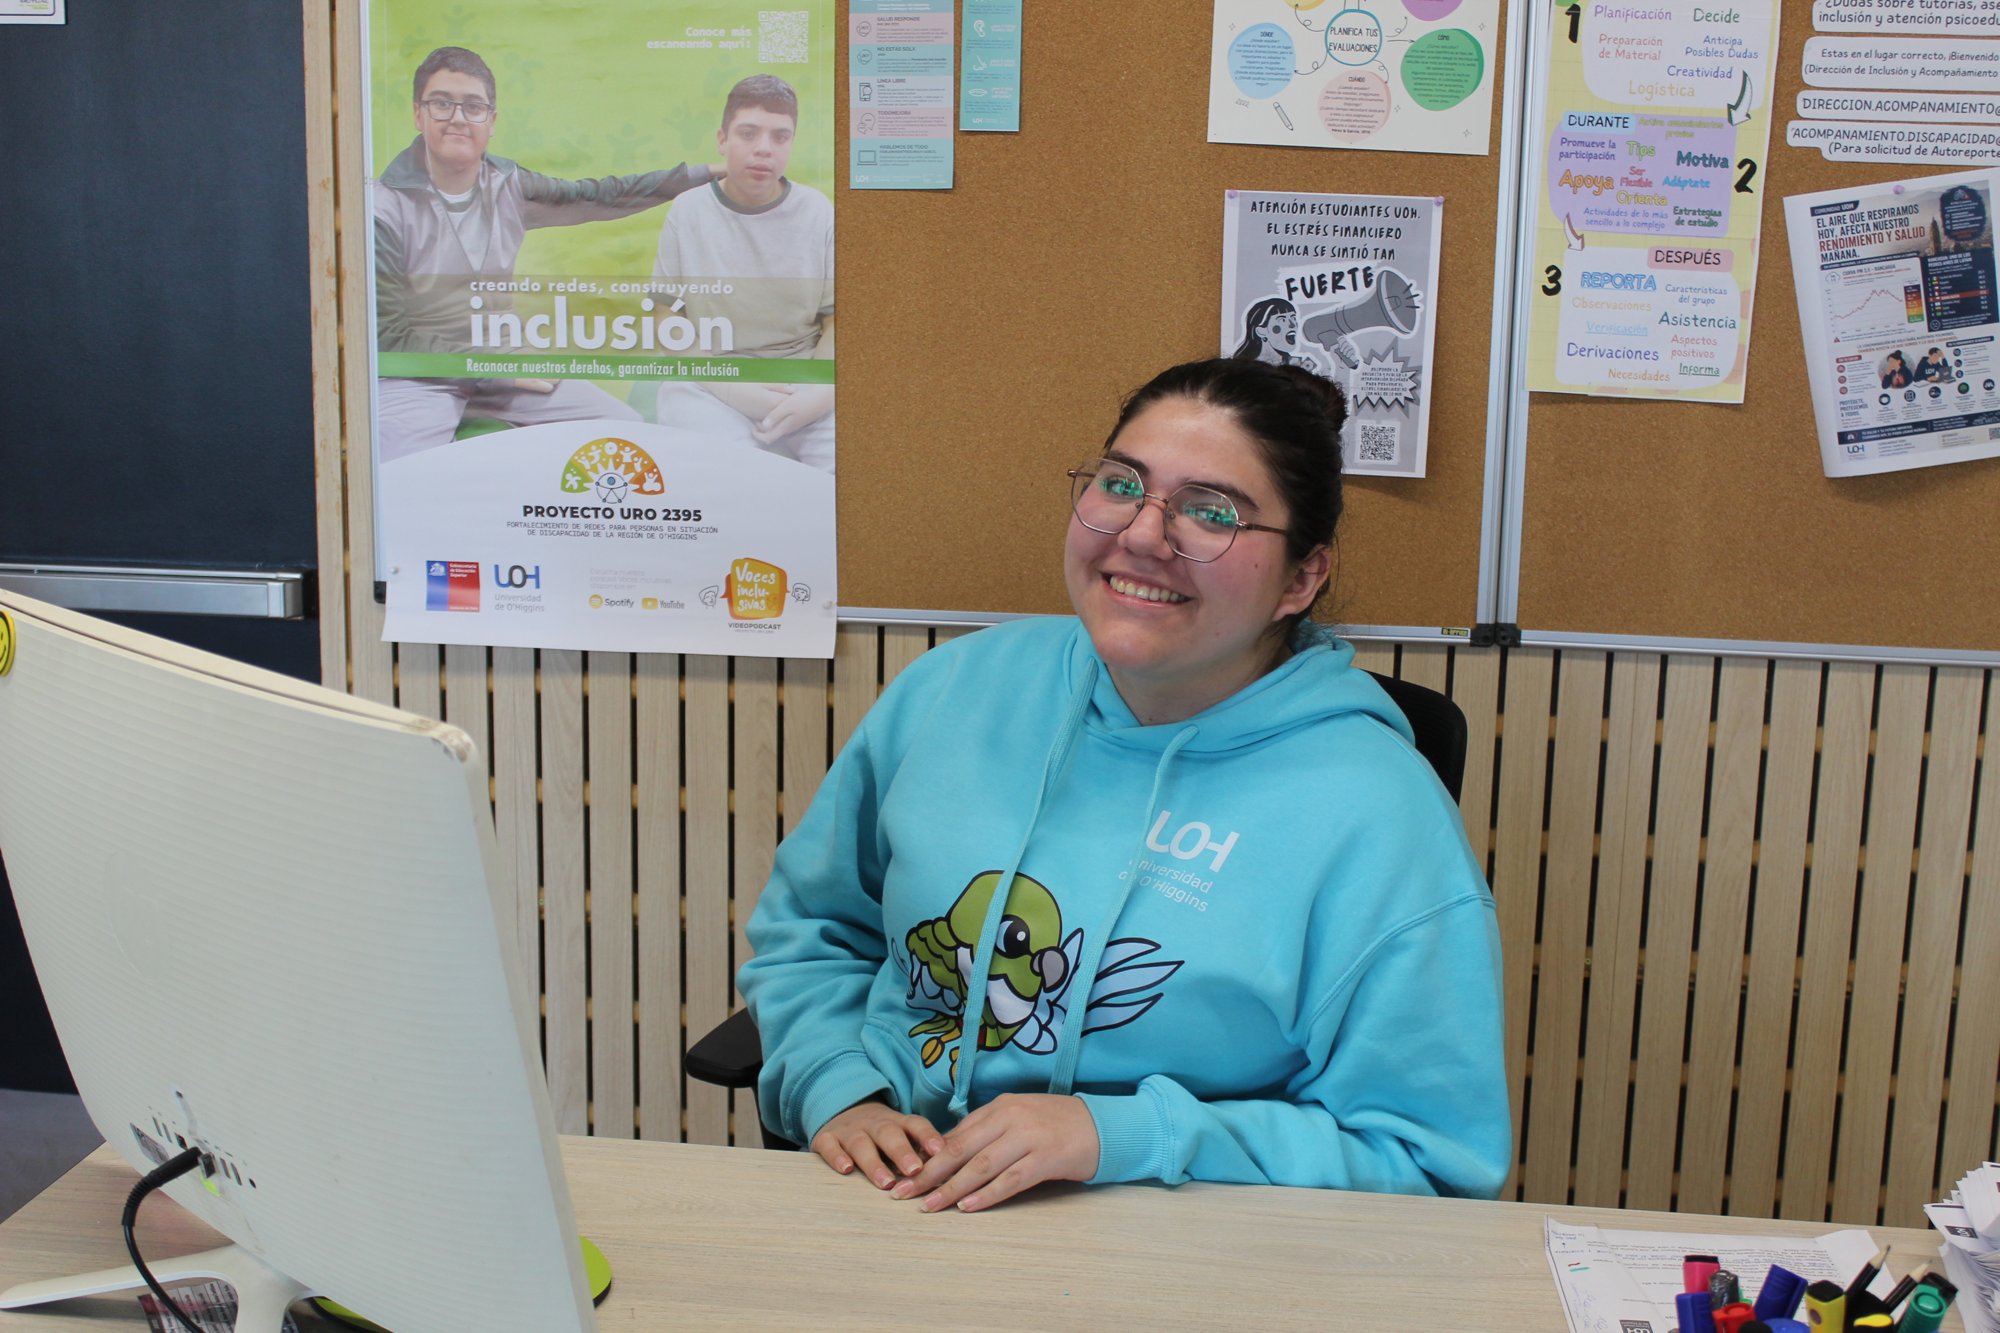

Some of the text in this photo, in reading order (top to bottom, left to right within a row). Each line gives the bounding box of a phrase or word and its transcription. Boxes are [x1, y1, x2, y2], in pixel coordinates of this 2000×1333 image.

[1594, 5, 1672, 22] Planificación
[1693, 8, 1740, 23] Decide
[1819, 11, 1872, 24] inclusión
[1875, 14, 1883, 27] y
[1887, 12, 1942, 25] atención
[1565, 3, 1581, 44] 1
[686, 27, 725, 37] Conoce
[1330, 26, 1378, 37] PLANIFICA TUS
[646, 40, 712, 49] escaneando
[1599, 33, 1663, 46] Preparación
[1703, 34, 1743, 47] Anticipa
[1328, 42, 1378, 53] EVALUACIONES
[1685, 47, 1759, 59] Posibles Dudas
[1598, 49, 1661, 61] de Material
[1821, 49, 1849, 58] Estas
[1851, 51, 1862, 59] en
[1864, 49, 1873, 59] el
[1874, 49, 1898, 61] lugar
[1667, 65, 1733, 79] Creatividad
[1804, 63, 1999, 79] (Dirección de Inclusión y Acompañamiento
[1629, 82, 1696, 101] Logística
[1568, 115, 1630, 129] DURANTE
[1560, 137, 1616, 149] Promueve la
[1828, 141, 1862, 155] (Para
[1865, 143, 1911, 156] solicitud
[1914, 144, 1928, 156] de
[1558, 149, 1615, 162] participación
[1625, 140, 1656, 161] Tips
[1676, 151, 1729, 169] Motiva
[1629, 166, 1646, 176] Ser
[1734, 158, 1757, 194] 2
[1558, 169, 1615, 196] Apoya
[1615, 190, 1669, 206] Orienta
[1251, 199, 1421, 219] ATENCIÓN ESTUDIANTES UOH.
[1583, 207, 1668, 219] Actividades de lo más
[1673, 206, 1722, 219] Estrategias
[1816, 204, 1920, 228] EL AIRE QUE RESPIRAMOS
[1585, 216, 1614, 227] sencillo
[1623, 217, 1630, 227] lo
[1632, 219, 1665, 230] complejo
[1675, 216, 1718, 228] de estudio
[1840, 223, 1871, 236] AFECTA
[1872, 217, 1910, 232] NUESTRO
[1267, 221, 1402, 239] EL ESTRÉS FINANCIERO
[1819, 226, 1926, 252] RENDIMIENTO Y SALUD
[1271, 243, 1395, 260] NUNCA SE SINTIÓ TAN
[1655, 249, 1721, 266] DESPUÉS
[1821, 248, 1861, 263] MAÑANA.
[470, 278, 733, 297] creando redes, construyendo
[1284, 265, 1374, 301] FUERTE
[1541, 265, 1562, 297] 3
[1581, 271, 1657, 291] REPORTA
[1665, 283, 1728, 295] Características
[1571, 297, 1652, 311] Observaciones
[1678, 295, 1716, 306] del grupo
[470, 296, 734, 351] inclusión
[1586, 320, 1648, 336] Verificación
[1658, 312, 1737, 330] Asistencia
[1671, 334, 1718, 346] Aspectos
[1567, 342, 1660, 361] Derivaciones
[1671, 348, 1715, 360] positivos
[466, 358, 739, 377] Reconocer nuestros derehos, garantizar la inclusión
[1679, 363, 1721, 377] Informa
[1608, 368, 1671, 382] Necesidades
[523, 505, 702, 522] PROYECTO URO 2395
[506, 521, 569, 530] FORTALECIMIENTO
[584, 523, 606, 531] REDES
[630, 524, 663, 532] PERSONAS
[680, 525, 718, 534] SITUACIÓN
[539, 529, 590, 537] DISCAPACIDAD
[593, 530, 602, 538] DE
[617, 530, 643, 539] REGIÓN
[736, 562, 776, 584] Voces
[737, 584, 769, 597] inclu-
[494, 594, 541, 602] Universidad
[604, 598, 634, 608] Spotify
[660, 600, 685, 610] YouTube
[494, 603, 544, 613] de O'Higgins
[738, 599, 768, 612] sivas
[728, 622, 781, 630] VIDEOPODCAST
[1129, 860, 1213, 894] niversidad
[1139, 876, 1208, 912] O'Higgins
